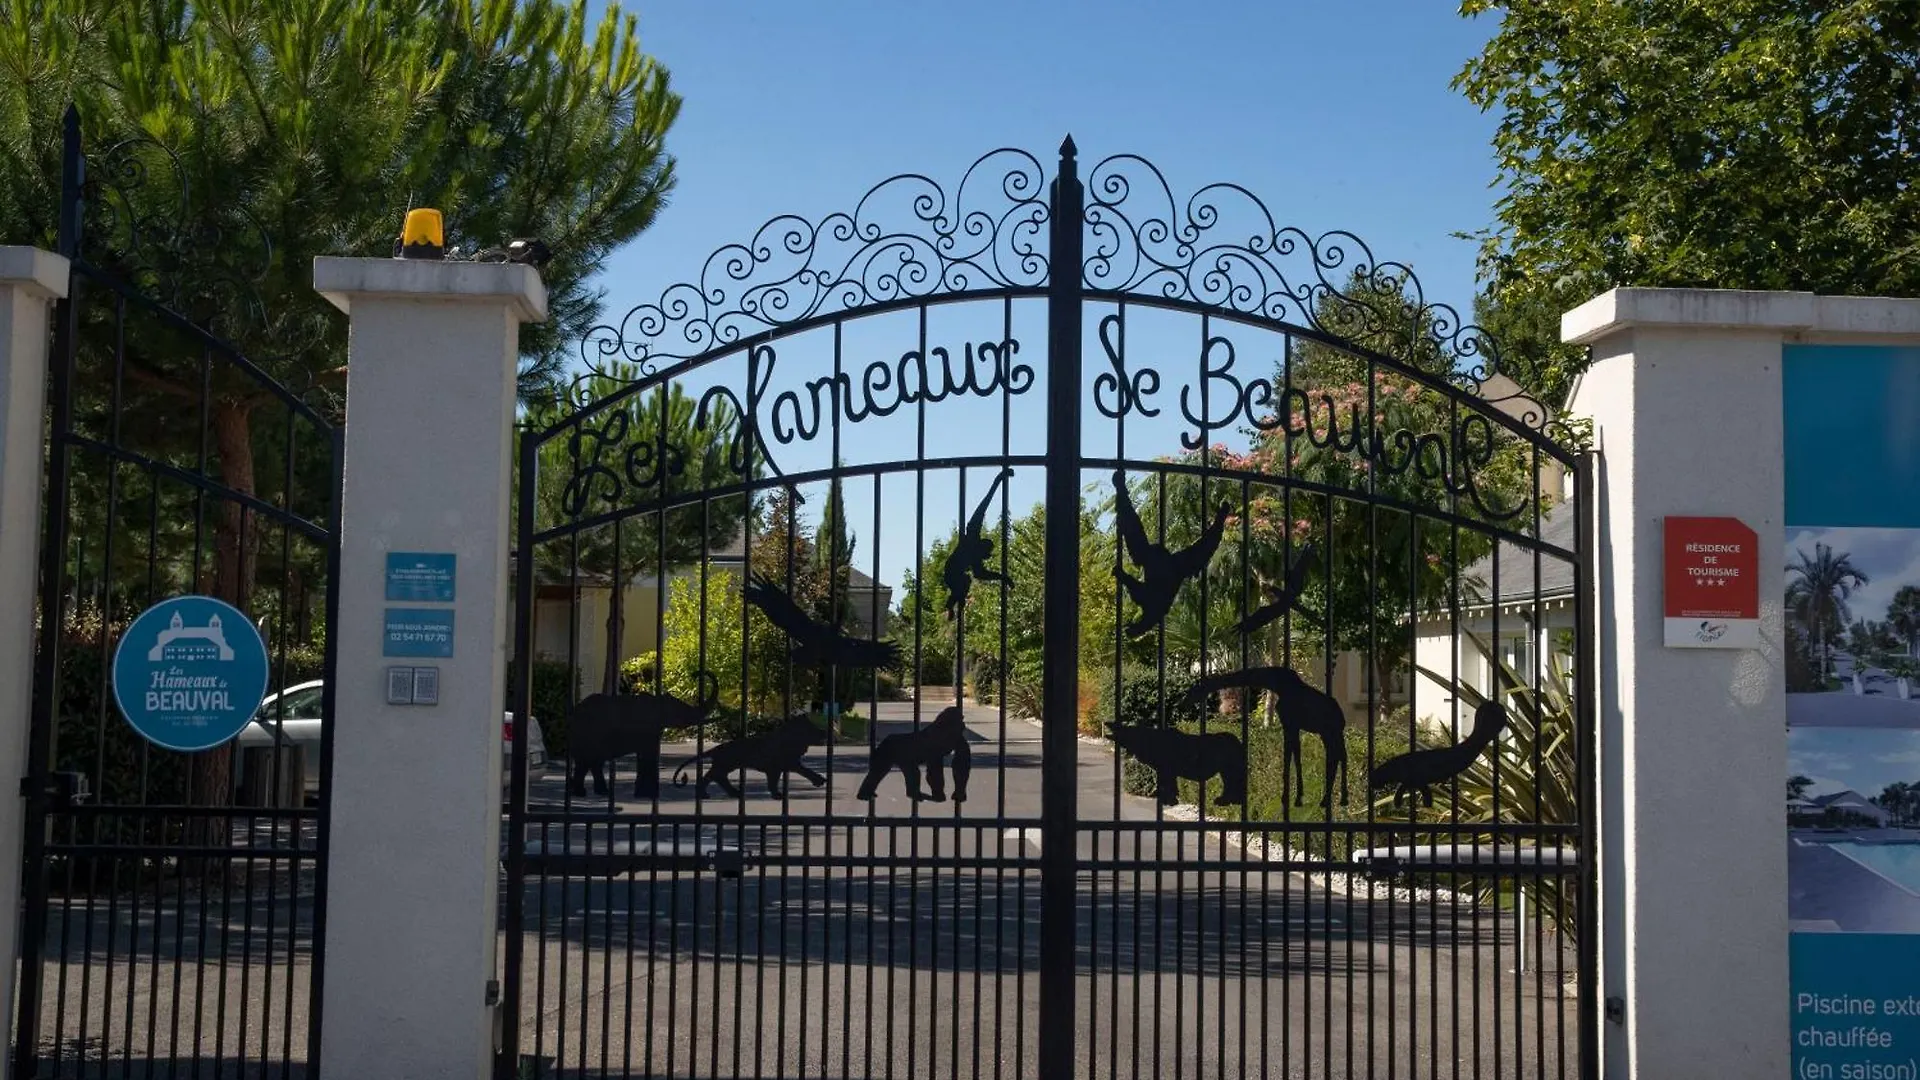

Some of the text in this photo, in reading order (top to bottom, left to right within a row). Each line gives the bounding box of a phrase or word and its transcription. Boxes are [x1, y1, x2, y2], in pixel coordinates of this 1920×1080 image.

[561, 408, 683, 517] Les
[1686, 543, 1741, 553] RÉSIDENCE
[1704, 556, 1717, 564] DE
[1688, 567, 1740, 577] TOURISME
[150, 670, 218, 689] Hameaux
[169, 665, 183, 675] Les
[146, 691, 235, 711] BEAUVAL
[1797, 992, 1876, 1015] Piscine
[1798, 1025, 1892, 1048] chauffée
[1800, 1056, 1917, 1080] (en saison)
